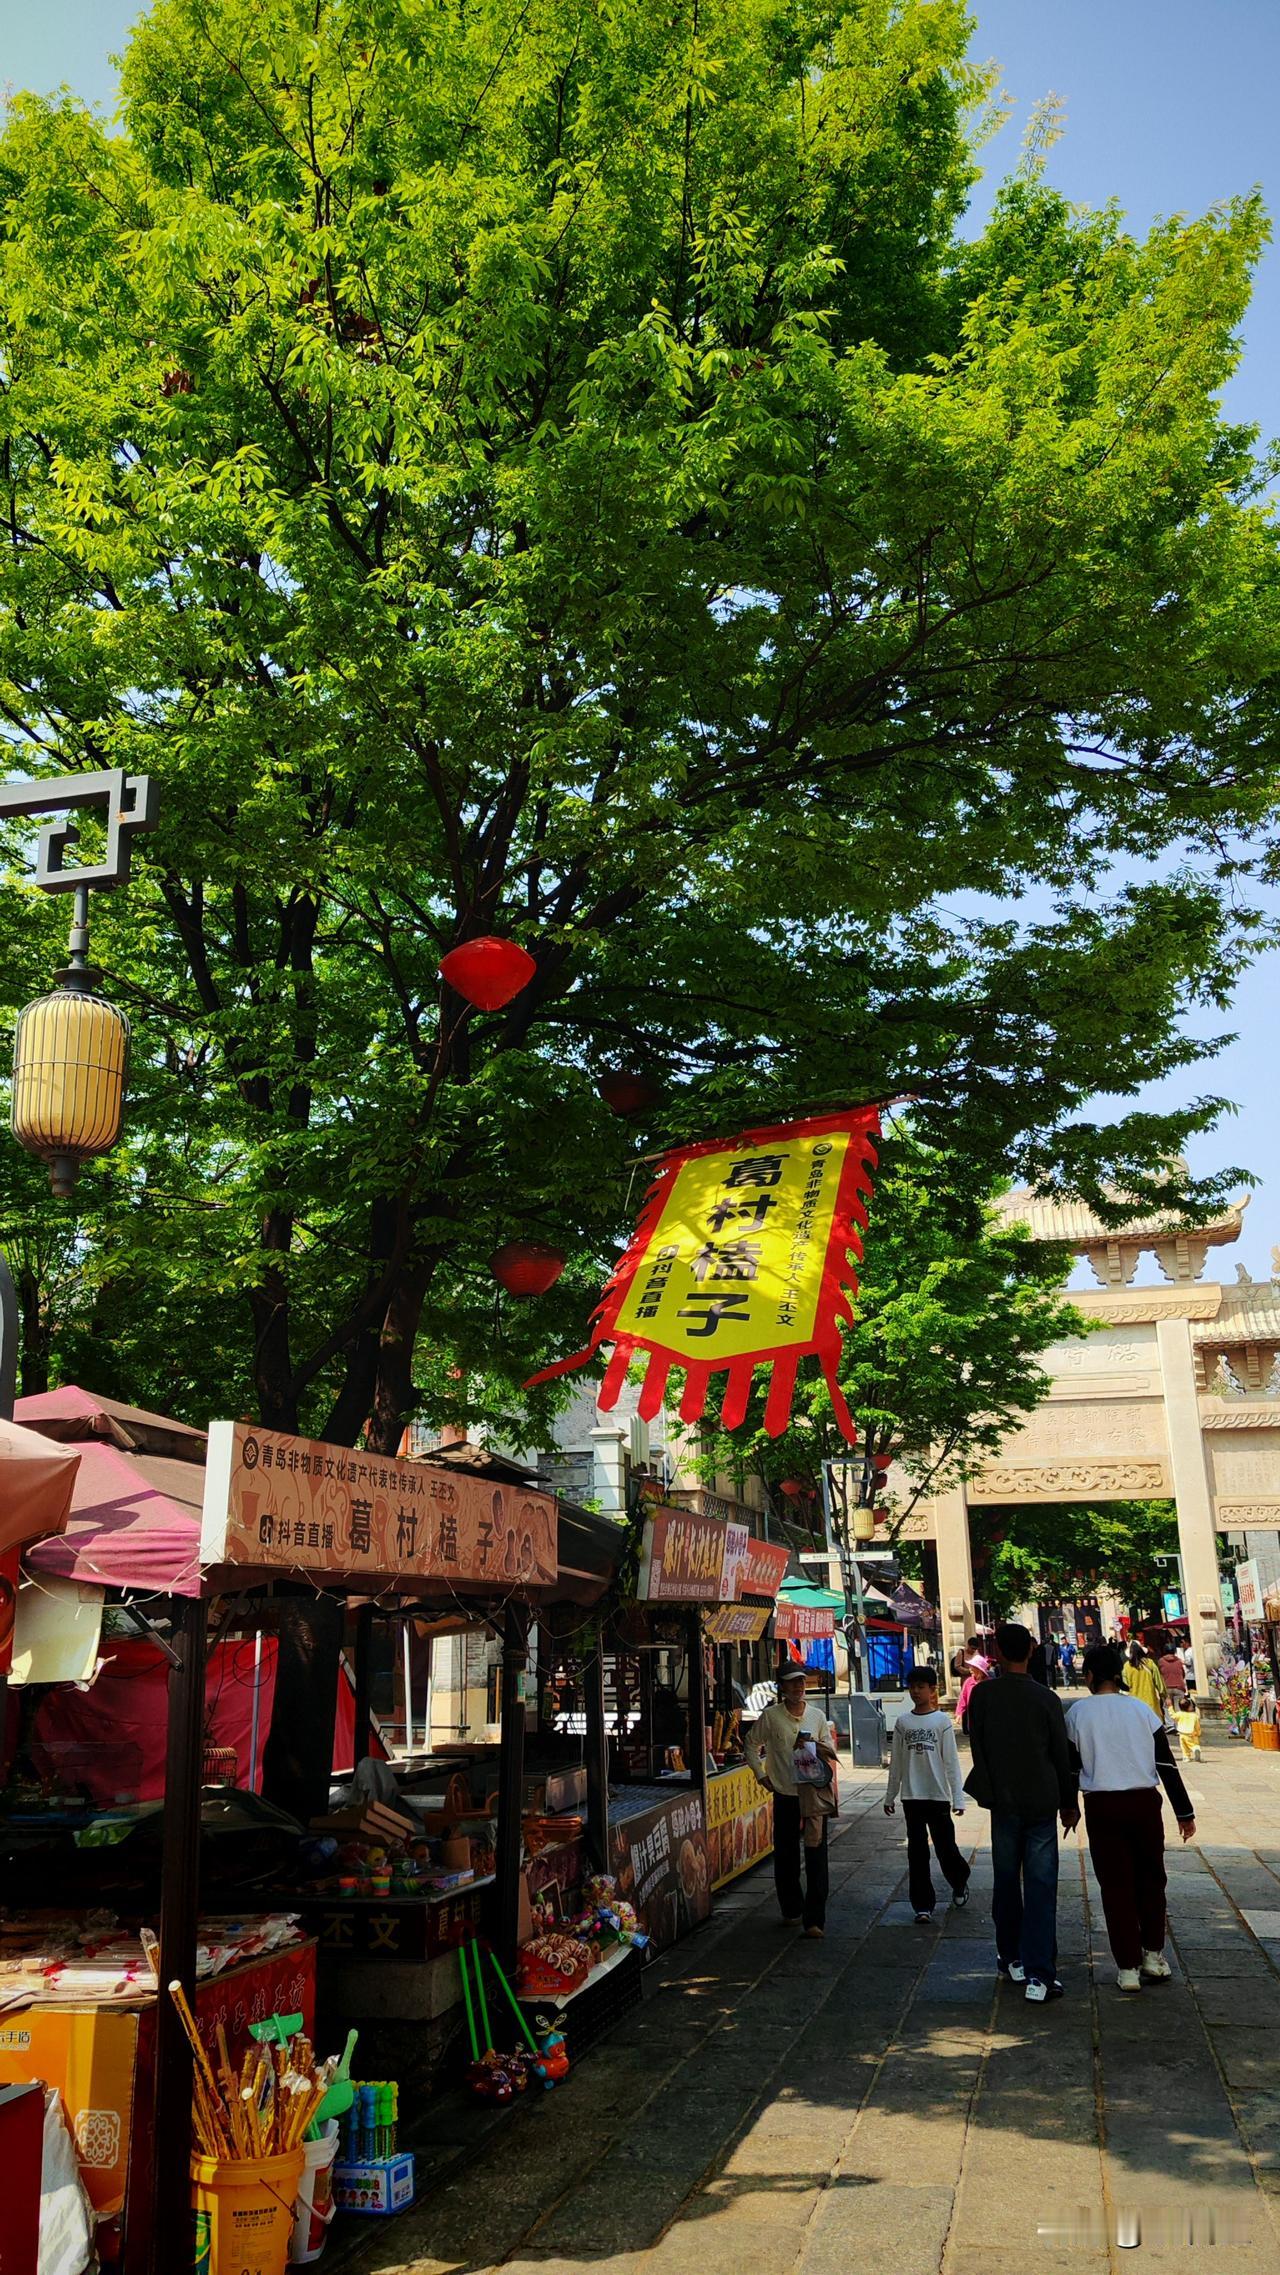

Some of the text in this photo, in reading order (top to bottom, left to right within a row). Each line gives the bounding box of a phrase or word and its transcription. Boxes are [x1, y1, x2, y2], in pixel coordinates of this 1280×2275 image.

[676, 1154, 790, 1337] 葛村榼子
[776, 1159, 826, 1327] 青岛非物质文化遗产传承人 王丕文
[635, 1262, 673, 1319] 抖音直播
[261, 1445, 425, 1495] 青岛非物质文化遗产代表性传承人
[278, 1519, 334, 1548] 抖音直播
[348, 1498, 495, 1566] 葛村榼子
[320, 1912, 401, 1951] 丕文
